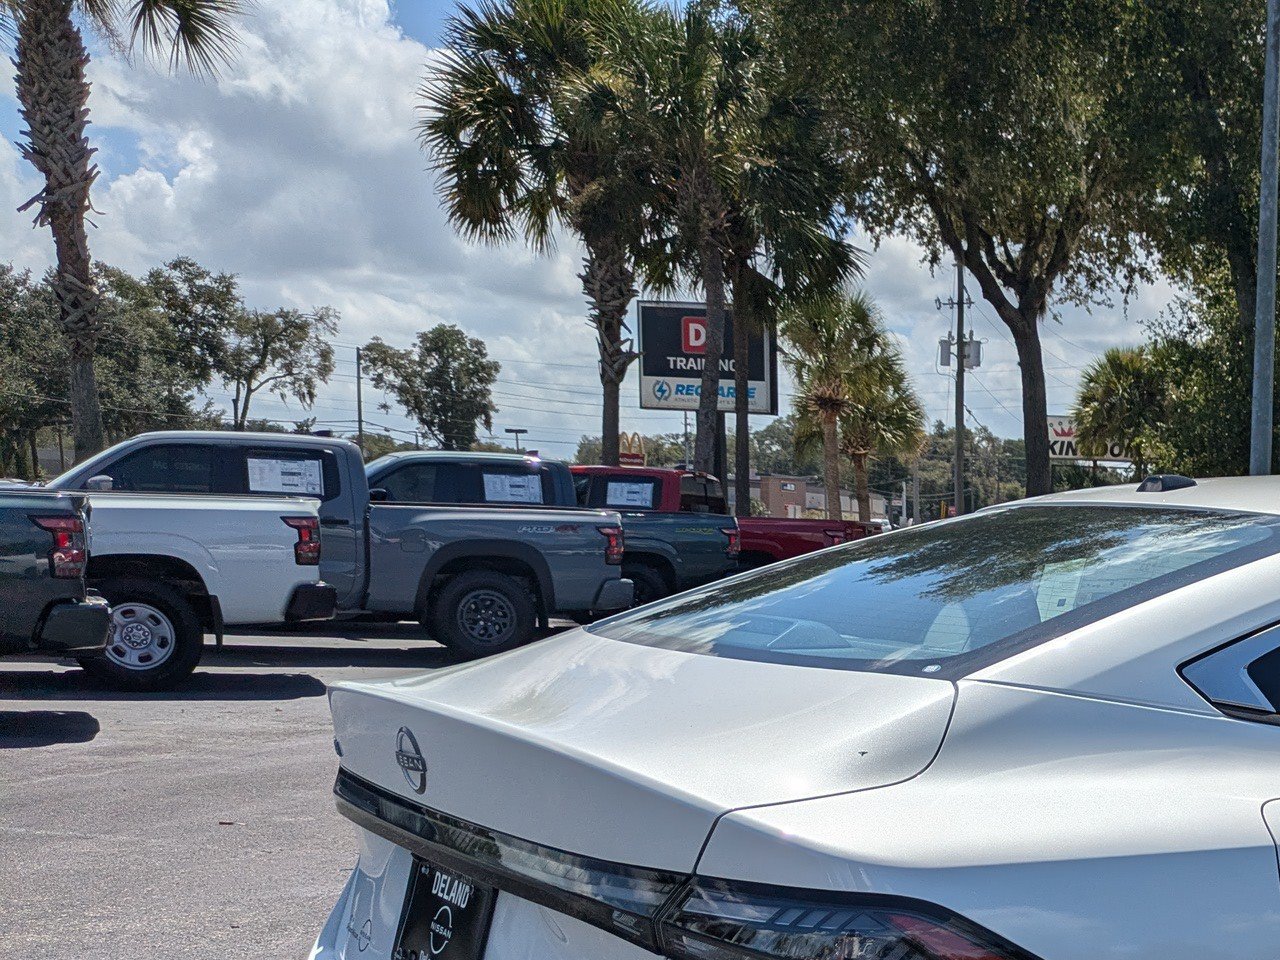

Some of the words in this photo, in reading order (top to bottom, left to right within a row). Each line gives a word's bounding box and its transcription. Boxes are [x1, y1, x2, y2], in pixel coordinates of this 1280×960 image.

[667, 356, 736, 372] TRAIN
[675, 383, 757, 399] RECARE
[1049, 440, 1133, 457] KINO
[431, 871, 471, 909] DELAND
[430, 921, 452, 939] NISSAN
